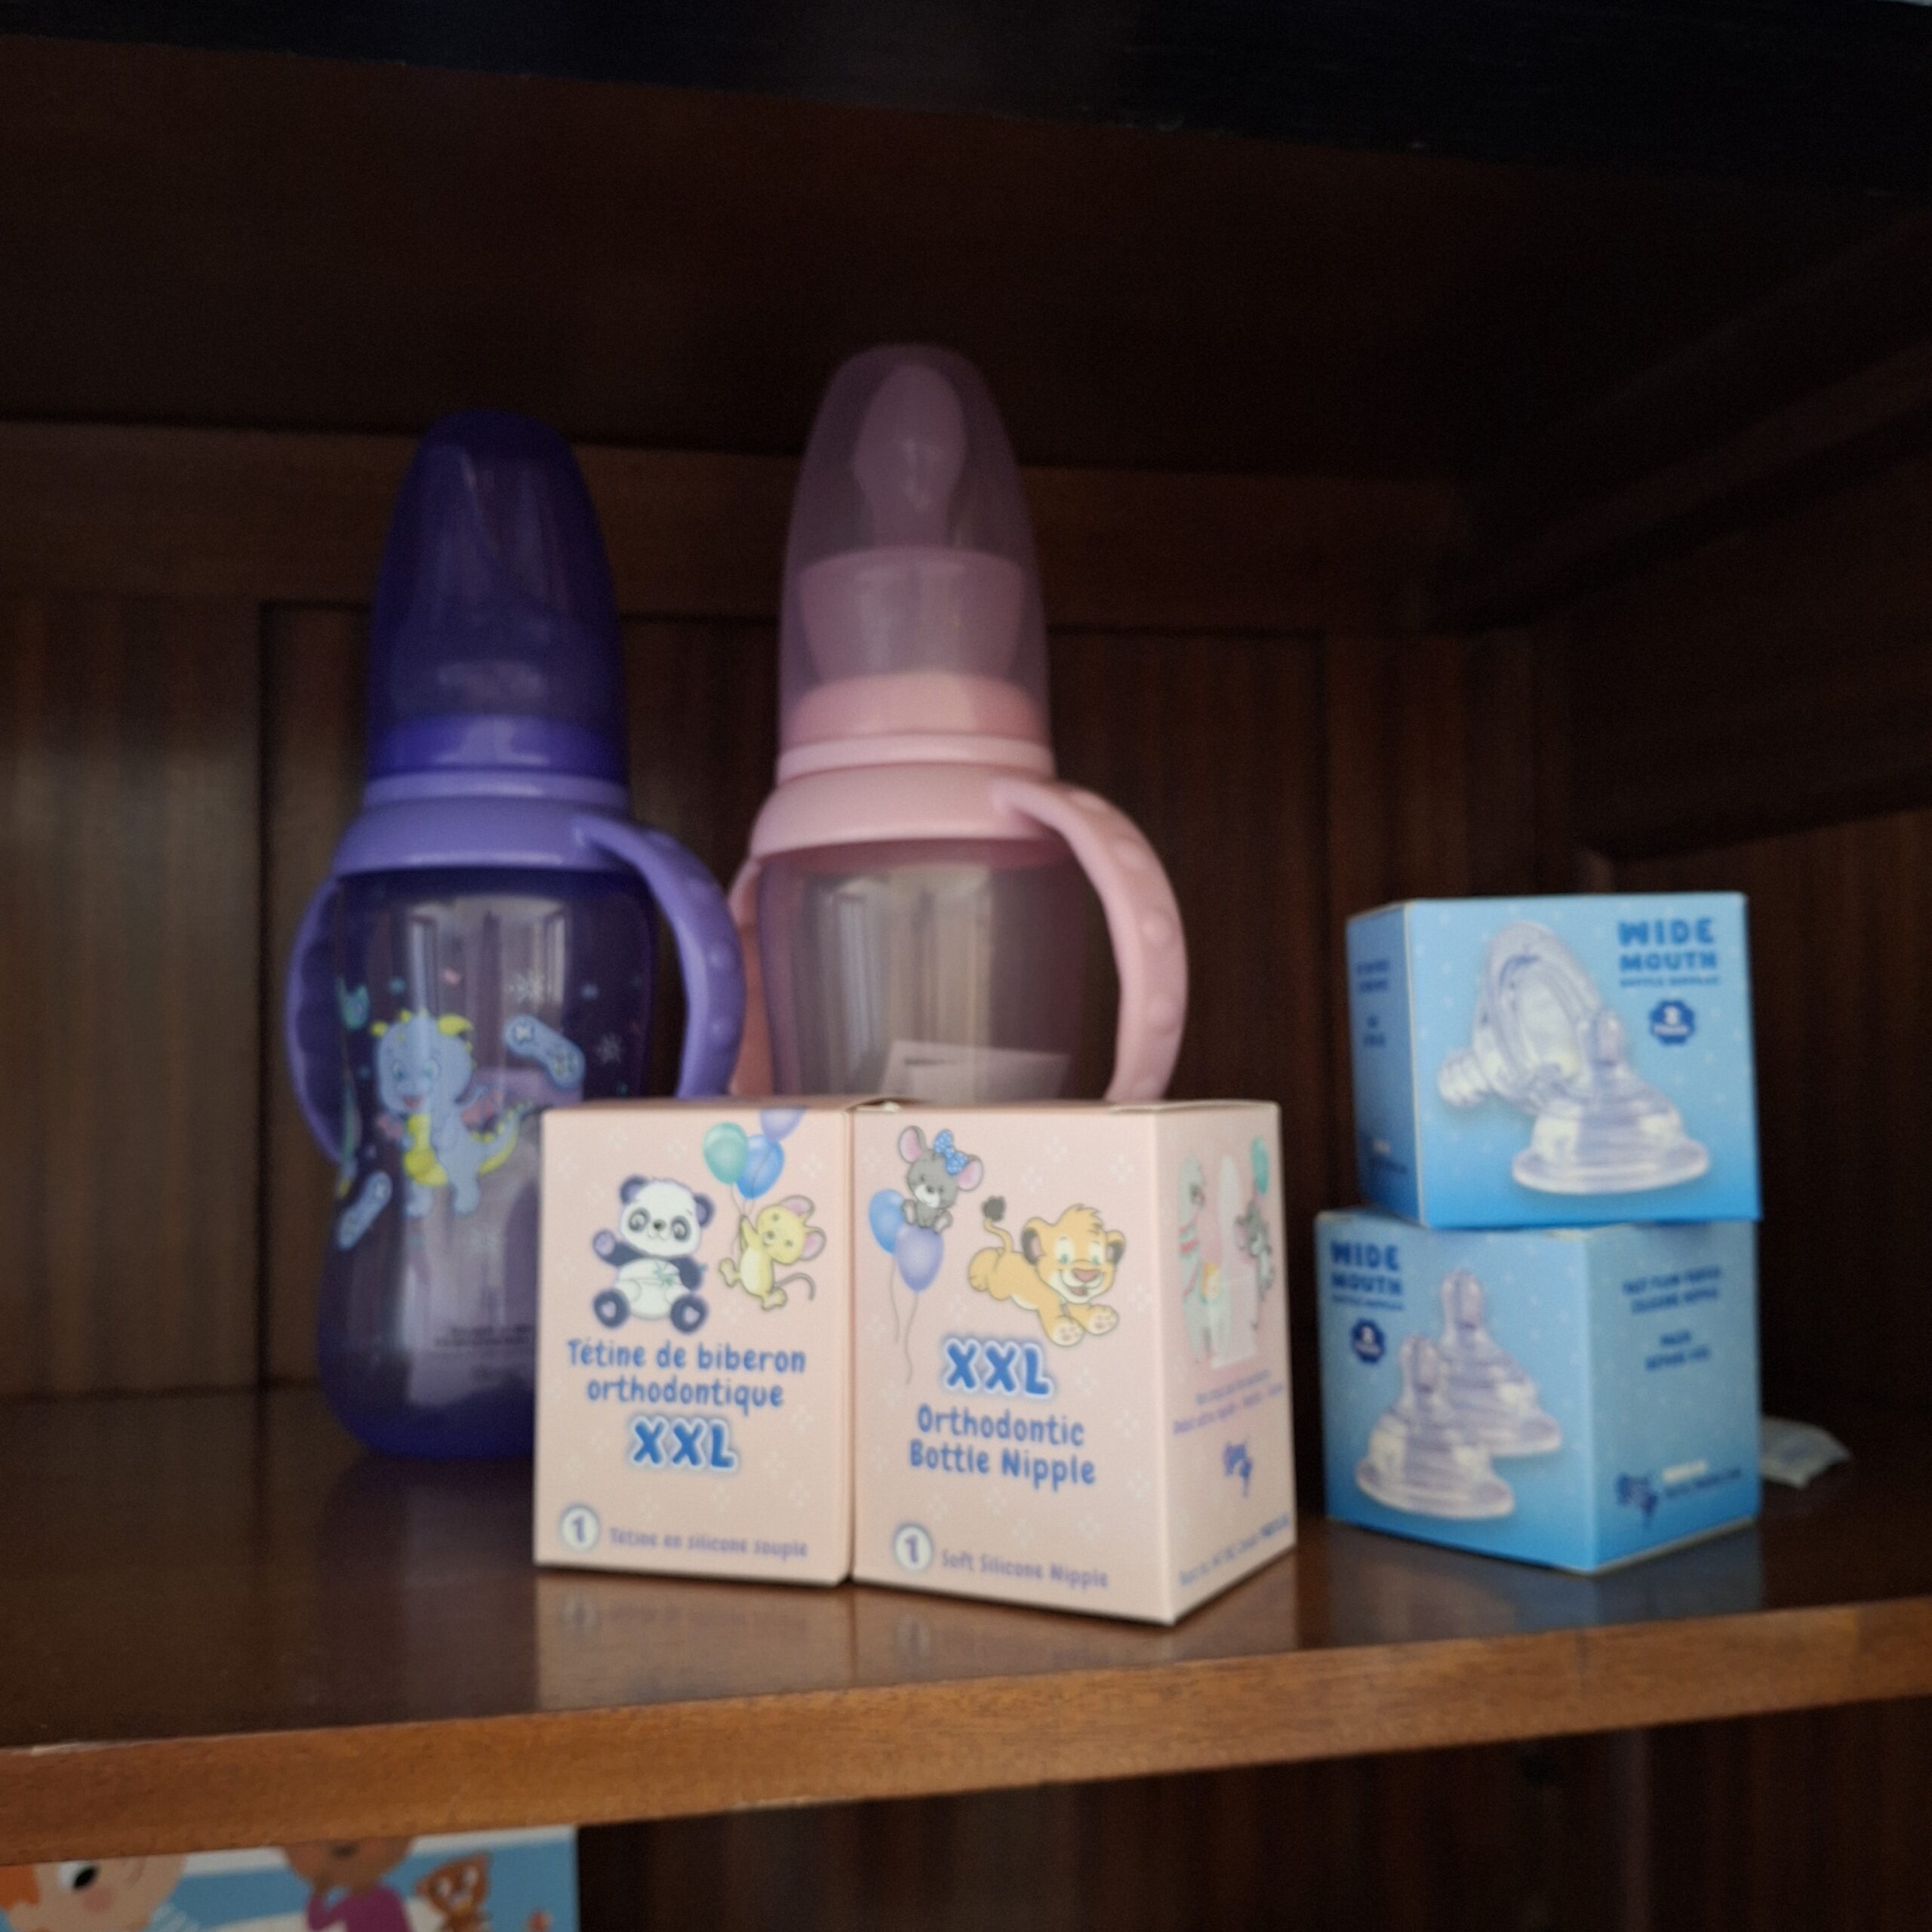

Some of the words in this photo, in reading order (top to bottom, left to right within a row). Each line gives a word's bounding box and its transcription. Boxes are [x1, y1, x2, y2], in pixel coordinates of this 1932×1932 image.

[1618, 918, 1715, 946] WIDE
[1619, 951, 1718, 972] MOUTH
[1330, 1240, 1401, 1272] WIDE
[568, 1337, 647, 1369] Tétine
[656, 1339, 688, 1369] de
[697, 1341, 806, 1374] biberon
[946, 1341, 1051, 1395] XXL
[586, 1374, 785, 1418] orthodontique
[632, 1420, 736, 1469] XXL
[917, 1403, 1085, 1447] Orthodontic
[909, 1438, 990, 1475] Bottle
[1001, 1446, 1097, 1493] Nipple
[571, 1515, 586, 1543] 1
[688, 1534, 749, 1555] silicone
[754, 1540, 809, 1562] souple
[906, 1535, 918, 1564] 1
[942, 1549, 974, 1571] Soft
[980, 1553, 1043, 1582] Silicone
[1050, 1562, 1109, 1591] Nipple
